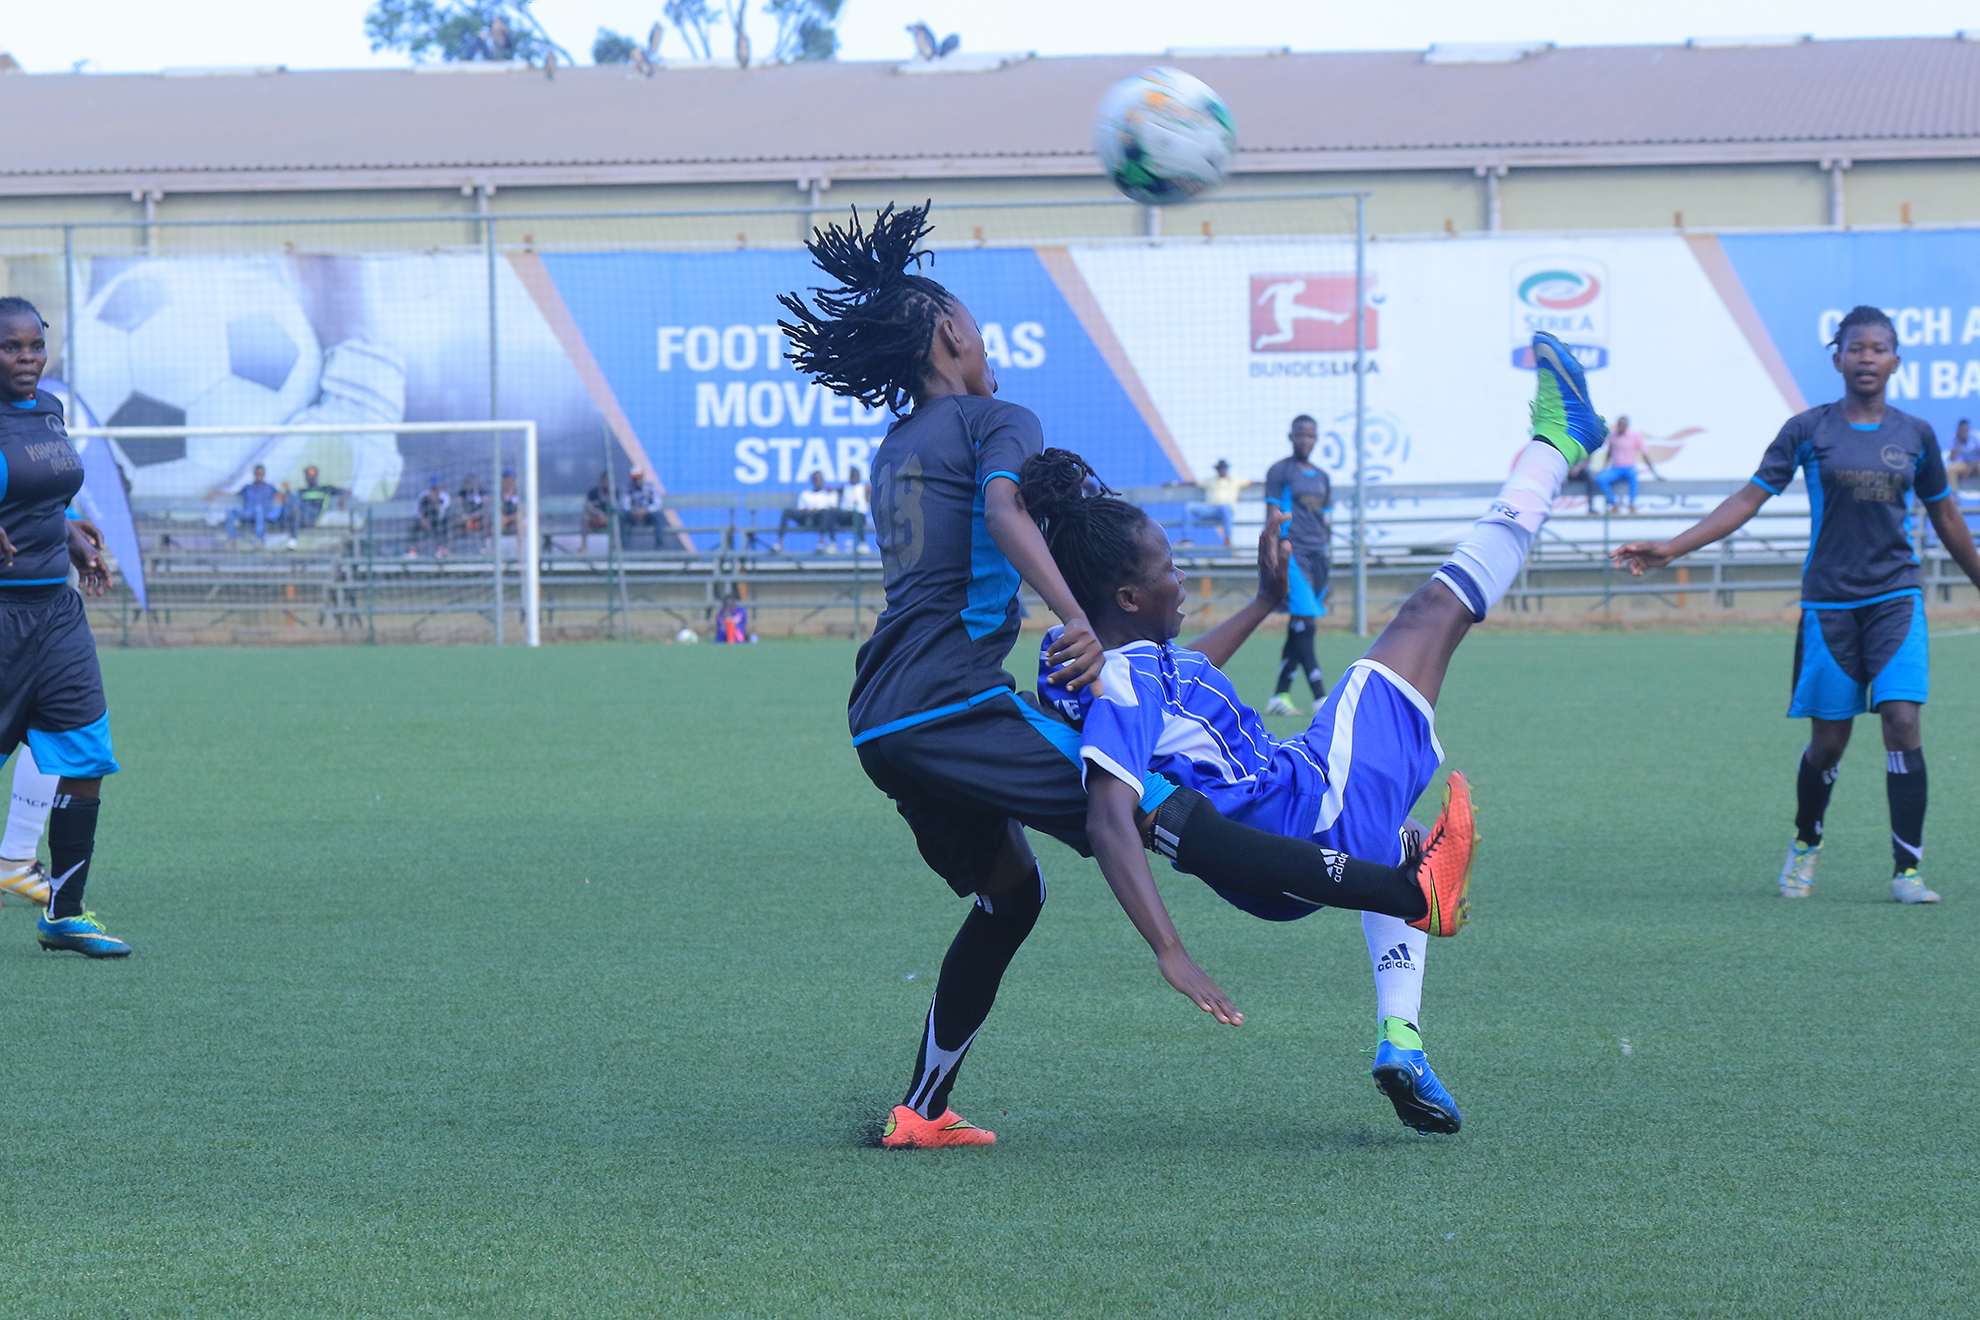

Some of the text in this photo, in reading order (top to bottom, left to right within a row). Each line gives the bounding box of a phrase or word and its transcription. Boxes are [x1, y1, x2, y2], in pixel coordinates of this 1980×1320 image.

[1817, 306, 1951, 347] CCH
[657, 321, 1046, 372] FOOT AS
[24, 440, 80, 462] KAMPAL
[50, 456, 84, 476] QUEEN
[733, 436, 882, 484] STAR
[1333, 852, 1350, 884] adida
[1377, 960, 1417, 973] adidas
